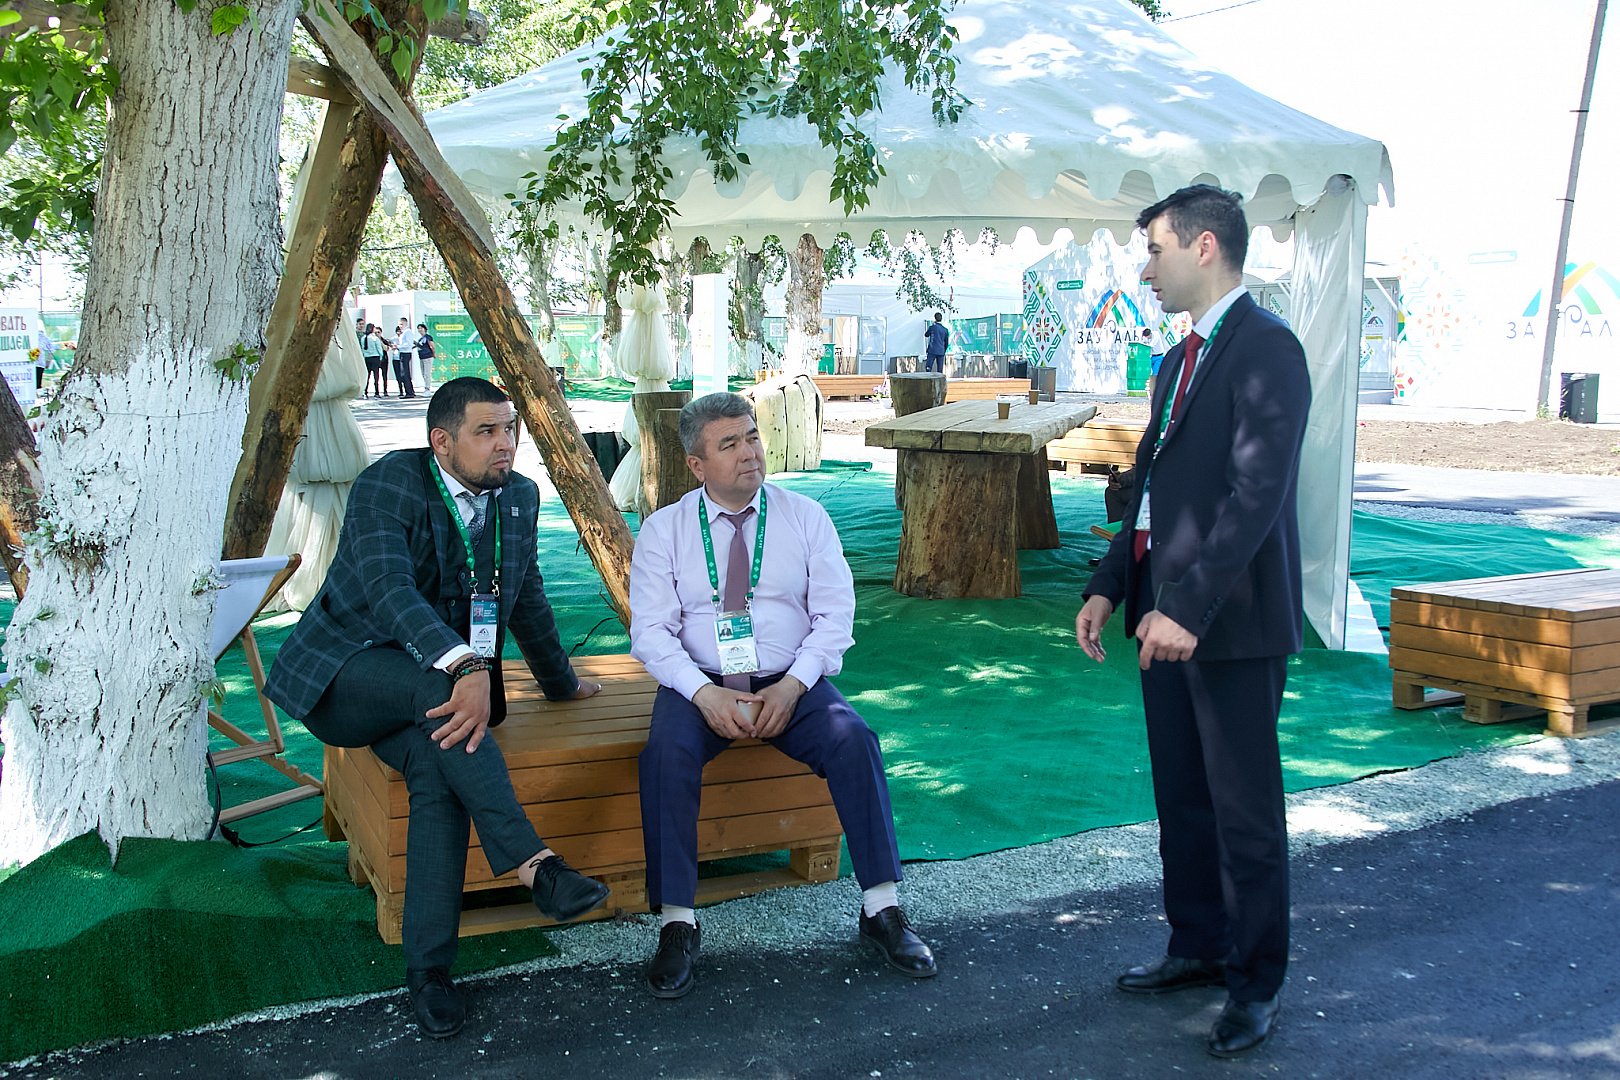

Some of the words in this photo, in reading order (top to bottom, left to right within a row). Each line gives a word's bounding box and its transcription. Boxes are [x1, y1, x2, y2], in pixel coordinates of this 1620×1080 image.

[0, 316, 27, 331] ВАТЬ
[1077, 319, 1145, 344] ЗАУРАЛЬ
[1506, 304, 1613, 339] ЗАРАЛ
